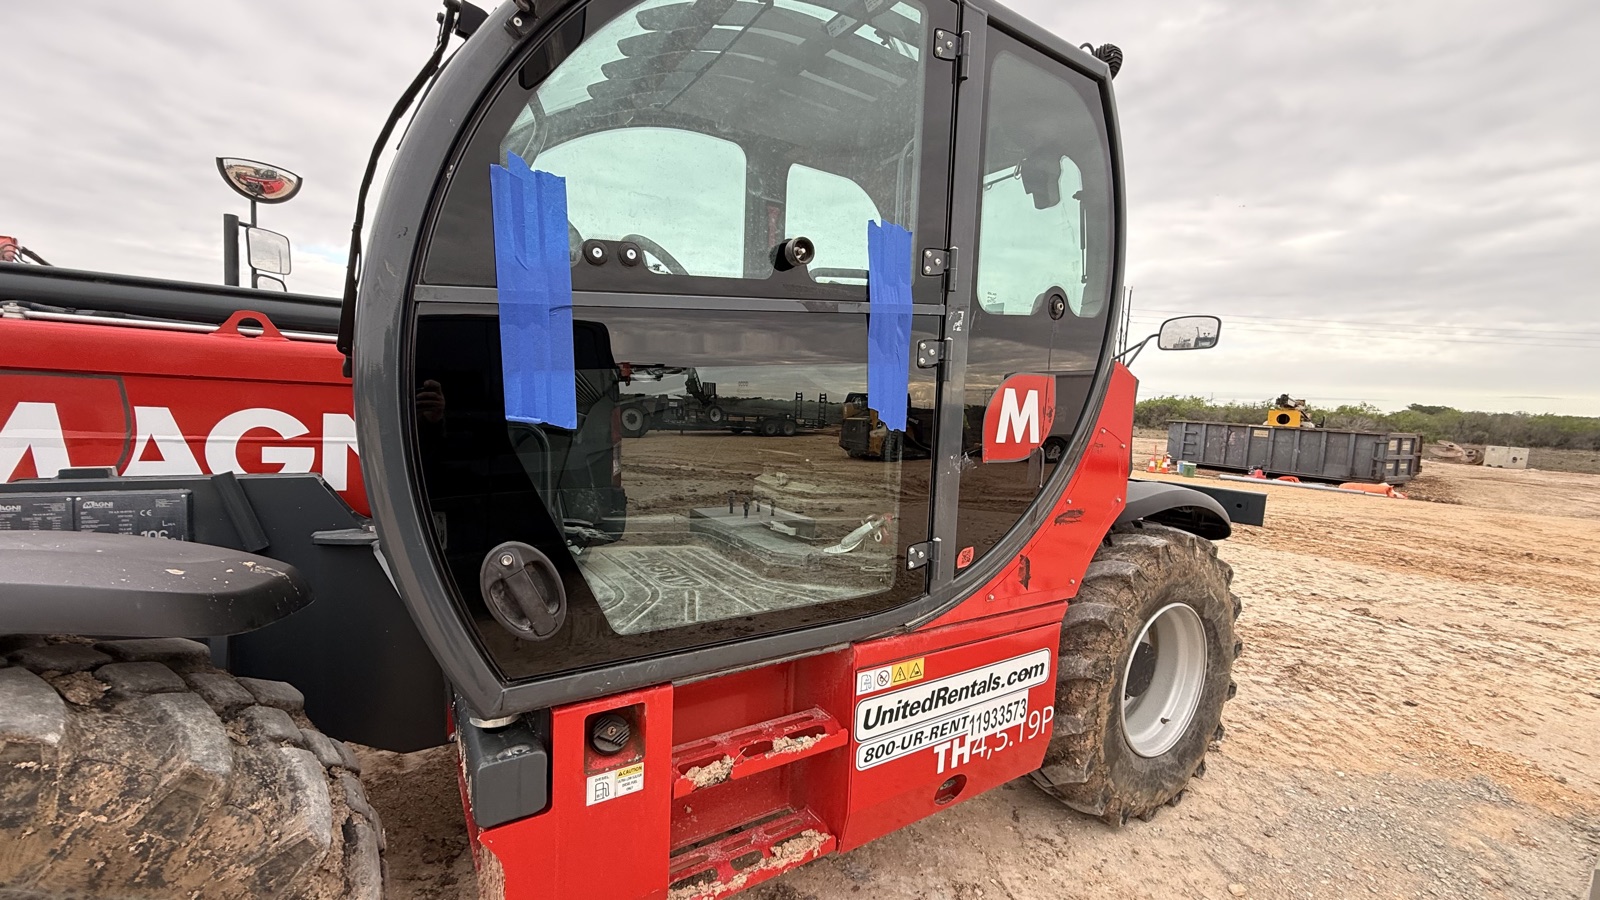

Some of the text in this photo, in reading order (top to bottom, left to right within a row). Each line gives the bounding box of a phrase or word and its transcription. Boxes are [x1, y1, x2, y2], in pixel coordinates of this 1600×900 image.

[996, 388, 1040, 444] M
[863, 661, 1045, 731] UnitedRentals.com
[969, 698, 1027, 737] 11933573
[864, 715, 970, 763] 800-UR-RENT
[623, 765, 643, 775] CAUTION
